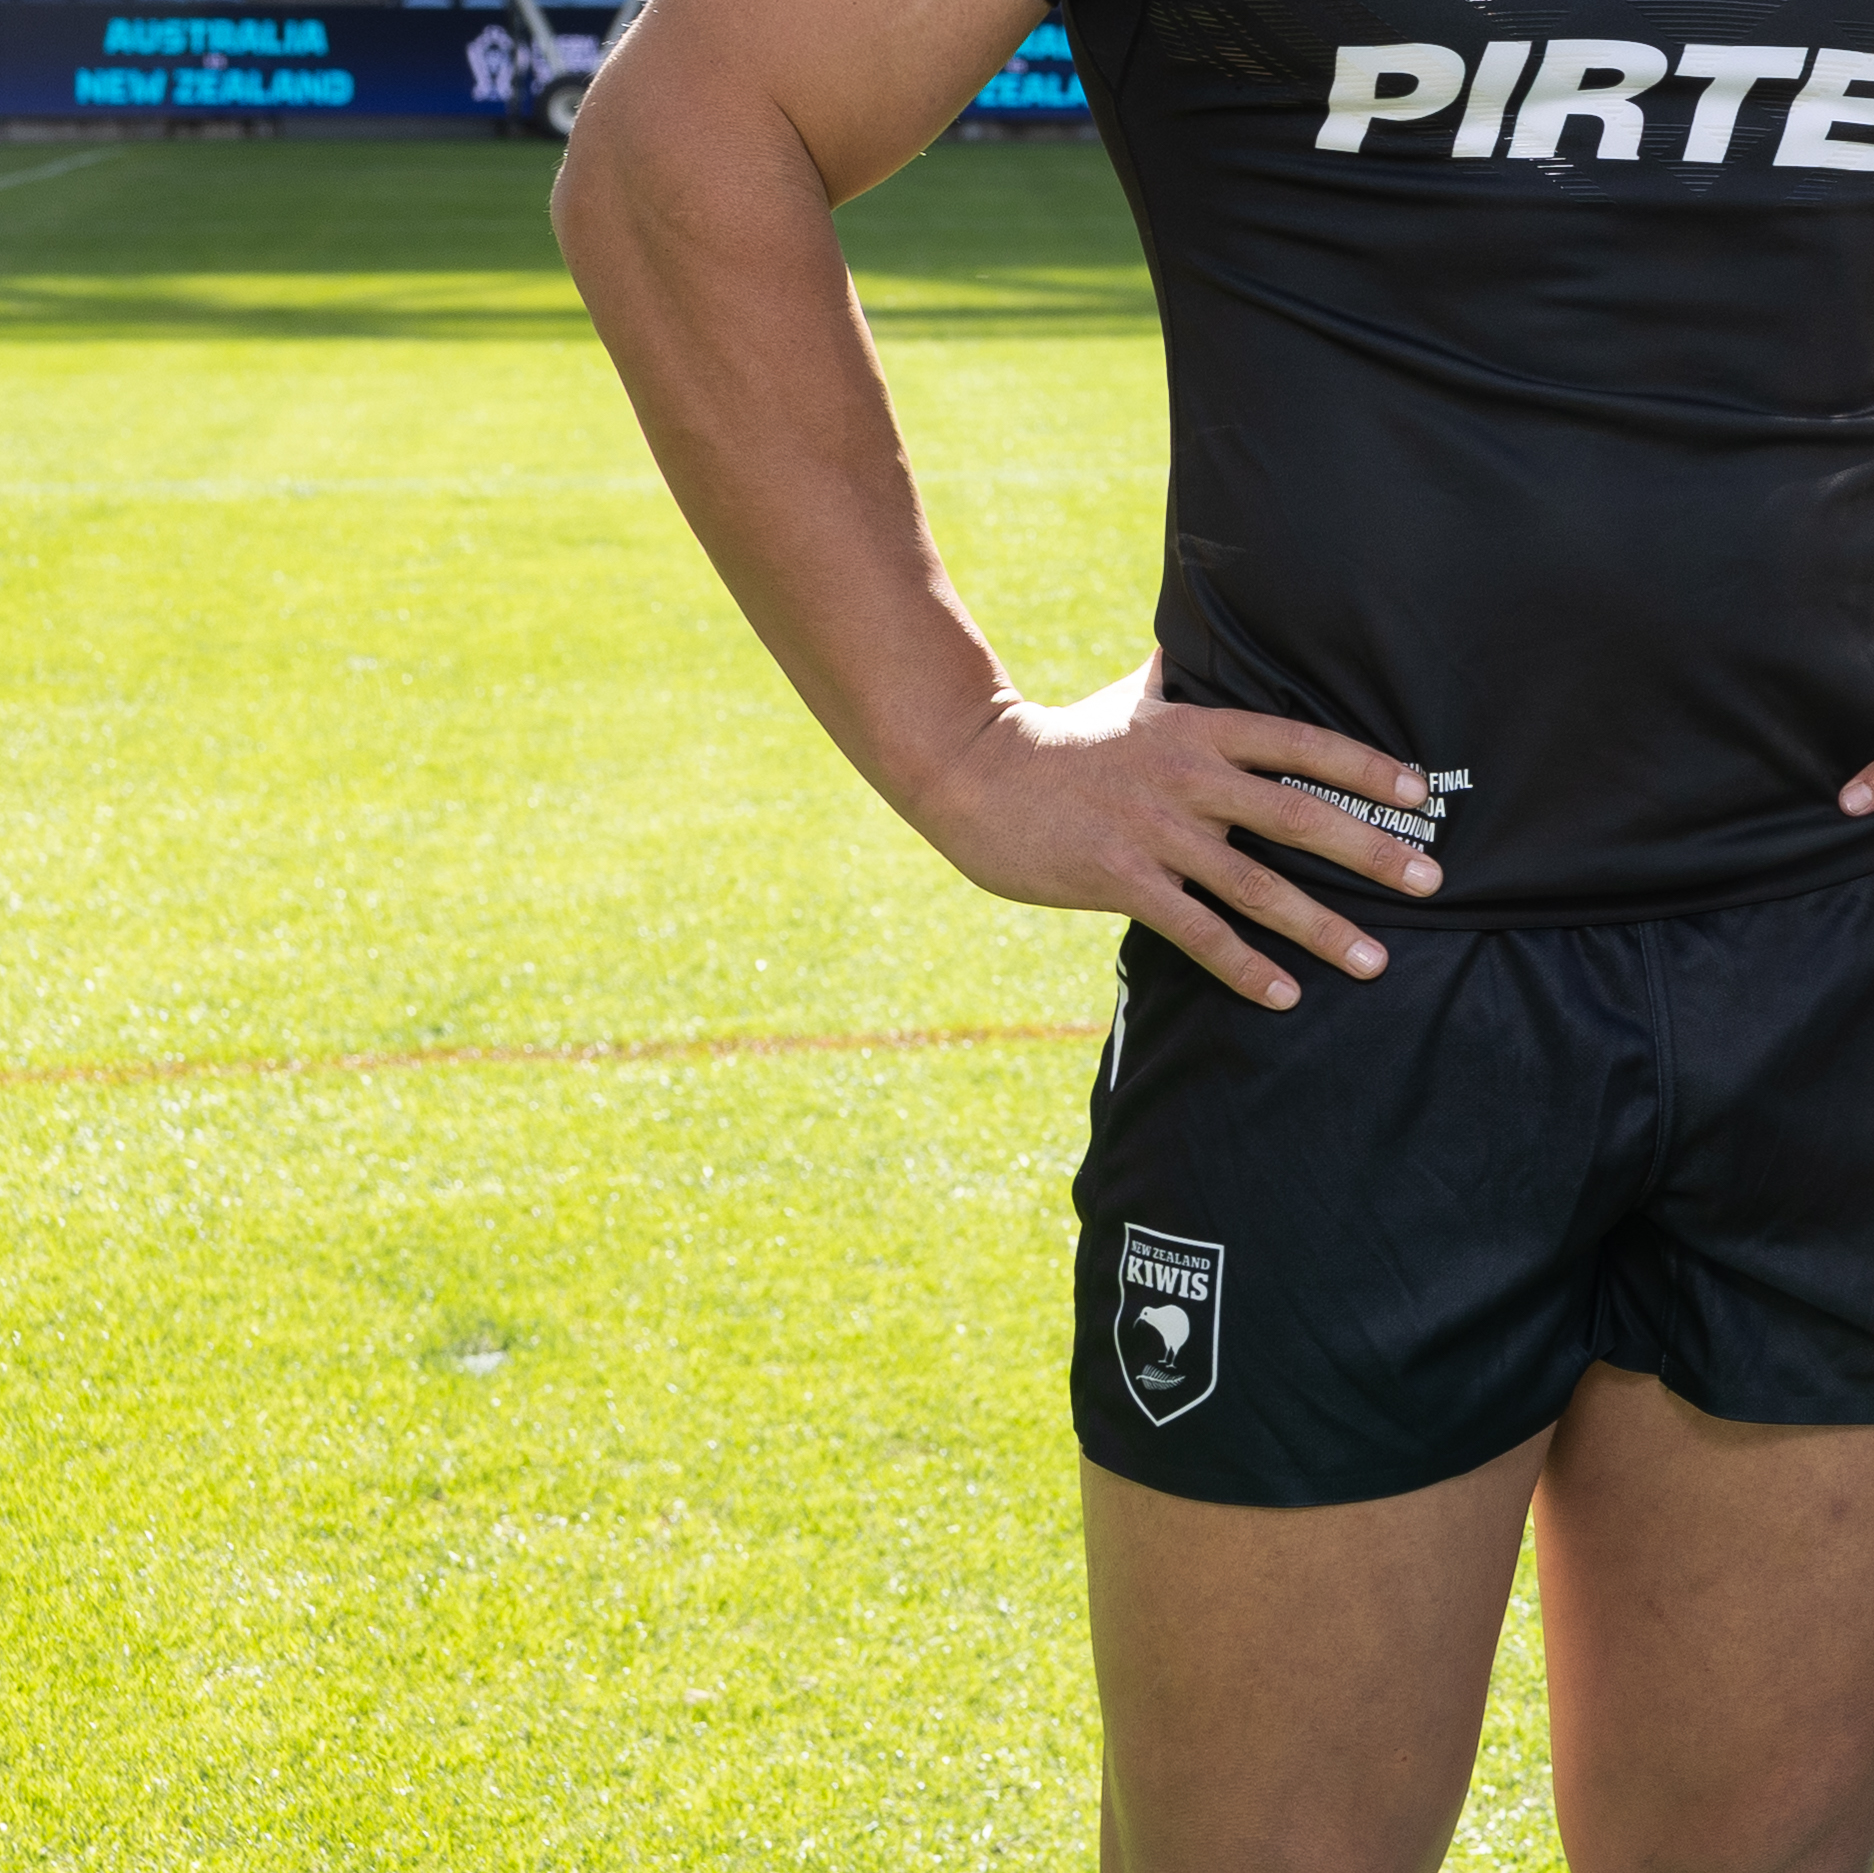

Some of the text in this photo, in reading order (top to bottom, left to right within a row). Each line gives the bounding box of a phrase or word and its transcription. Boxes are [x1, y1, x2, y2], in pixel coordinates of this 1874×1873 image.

[103, 17, 328, 56] AUSTRALIA
[74, 67, 355, 106] NEW ZEALAND
[1429, 768, 1473, 793] FINAL
[1370, 805, 1436, 843] STADIUM
[1131, 1239, 1211, 1271] NEW ZEALAND
[1126, 1254, 1210, 1301] KIWIS
